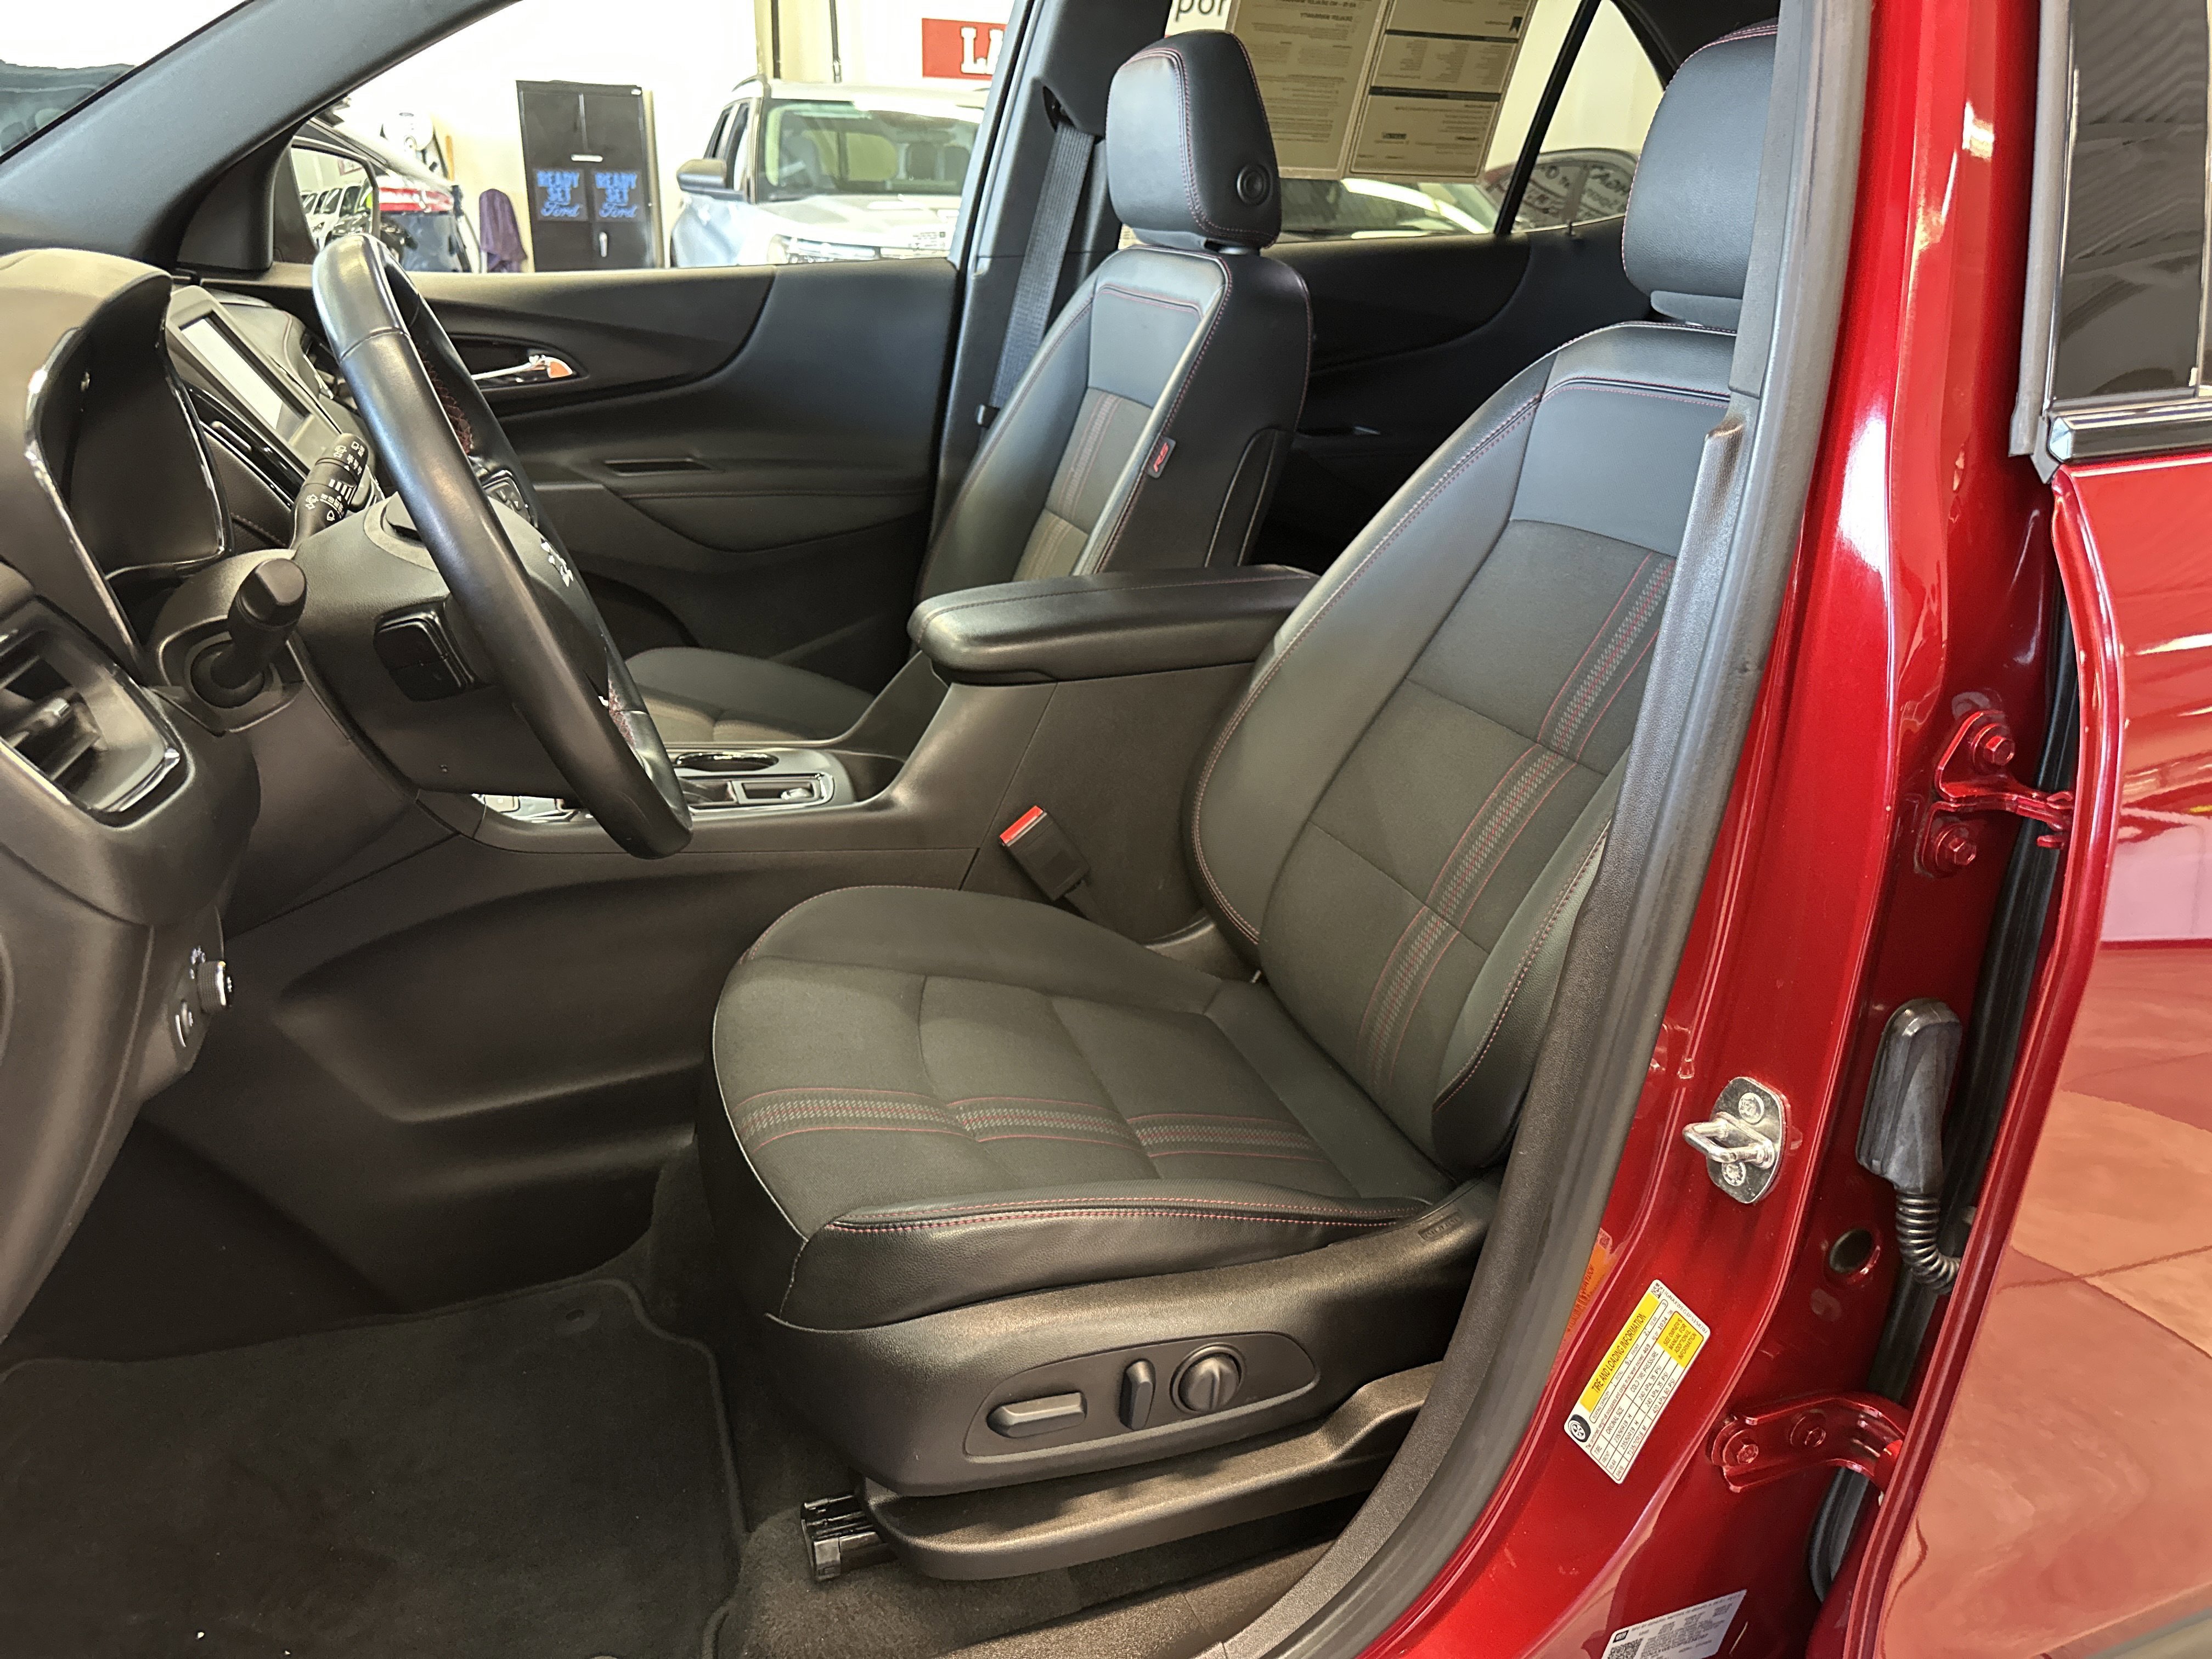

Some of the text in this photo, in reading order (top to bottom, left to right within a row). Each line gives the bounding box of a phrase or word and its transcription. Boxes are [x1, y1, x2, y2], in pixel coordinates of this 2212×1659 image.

[541, 201, 580, 217] Ford
[599, 202, 637, 218] Ford
[1154, 442, 1169, 473] RS
[1657, 1316, 1668, 1330] 1034
[1663, 1335, 1671, 1346] SEE
[1668, 1323, 1686, 1350] MANUAL FOR
[1674, 1328, 1691, 1354] ADDITIONAL
[1677, 1331, 1696, 1360] INFORMATION
[1591, 1310, 1646, 1394] TIRE AND LOADING INFORMATION
[1630, 1379, 1640, 1393] COLD
[1637, 1370, 1645, 1381] TIRE
[1642, 1350, 1658, 1373] PRESSURE
[1650, 1373, 1656, 1381] 35
[1656, 1380, 1663, 1388] 35
[1661, 1370, 1669, 1381] PSI
[1663, 1386, 1670, 1395] 60
